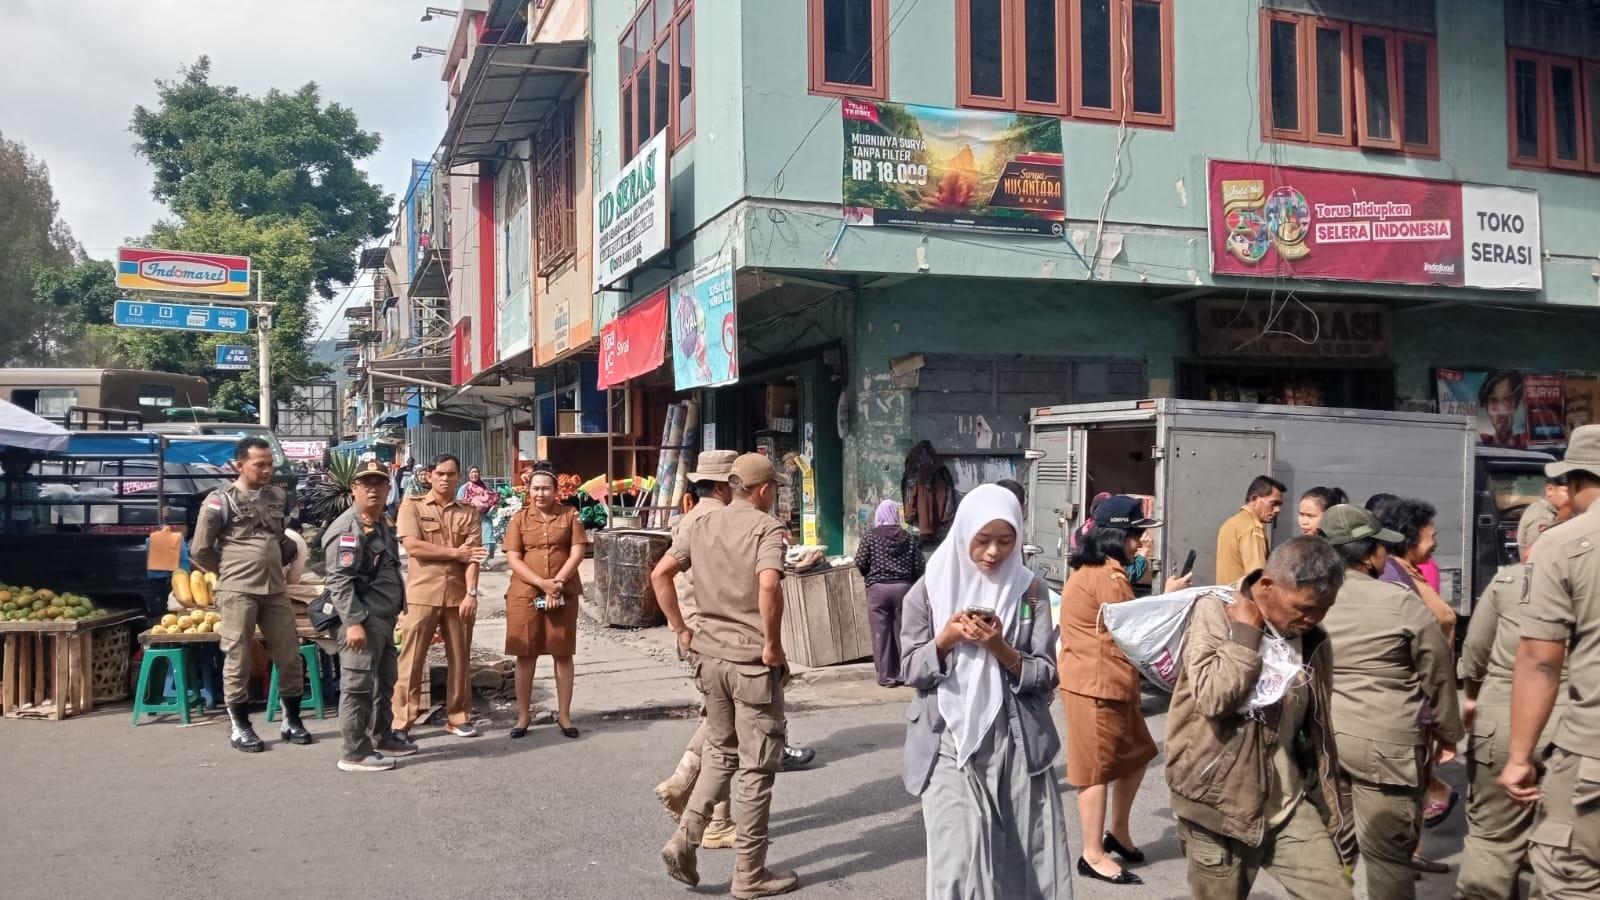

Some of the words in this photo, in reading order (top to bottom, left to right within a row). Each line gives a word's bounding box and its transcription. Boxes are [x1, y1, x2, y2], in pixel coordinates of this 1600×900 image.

[851, 133, 898, 149] MURNINYA
[900, 138, 927, 151] SURYA
[853, 145, 881, 159] TANPA
[882, 149, 911, 161] FILTER
[852, 159, 872, 181] RP
[1020, 168, 1045, 180] Surya
[598, 193, 615, 233] UD
[616, 147, 657, 218] SERASI
[1004, 178, 1061, 198] NUSANTARA
[1019, 197, 1049, 205] RAYA
[1314, 203, 1352, 219] Terus
[1352, 200, 1411, 220] Hidupkan
[1317, 224, 1369, 241] SELERA
[1374, 222, 1449, 238] INDONESIA
[1476, 211, 1524, 234] TOKO
[1471, 243, 1533, 265] SERASI
[144, 262, 224, 281] Indomaret
[1423, 262, 1455, 273] Indofood
